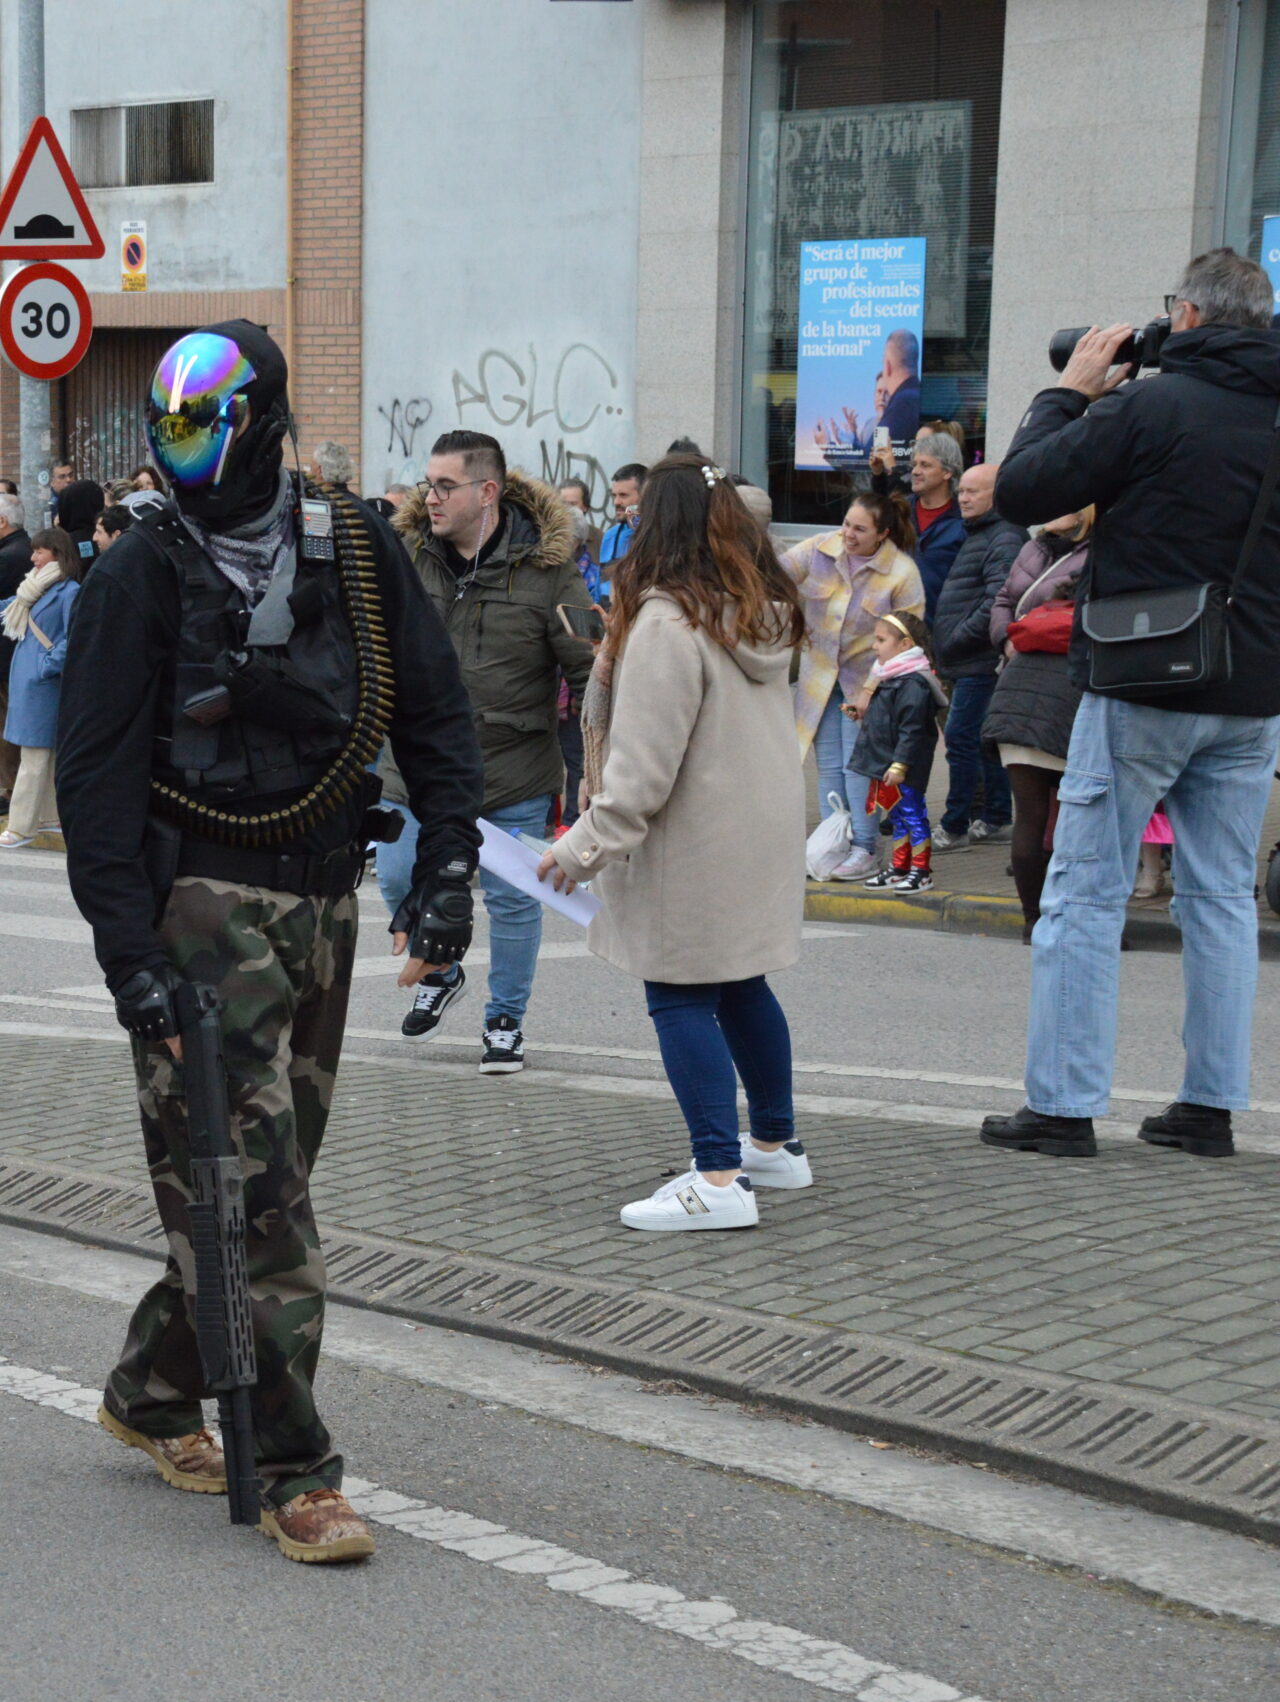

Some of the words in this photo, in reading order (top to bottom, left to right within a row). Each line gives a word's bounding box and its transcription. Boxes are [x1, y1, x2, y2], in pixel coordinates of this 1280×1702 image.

[845, 243, 859, 260] el
[861, 241, 905, 262] mejor
[803, 267, 847, 285] grupo
[850, 262, 868, 279] de
[822, 280, 920, 304] profesionales
[849, 300, 872, 318] del
[874, 302, 920, 317] sector
[21, 301, 71, 339] 30
[802, 320, 820, 338] de
[822, 320, 835, 337] la
[837, 320, 882, 337] banca
[802, 339, 871, 357] nacional”
